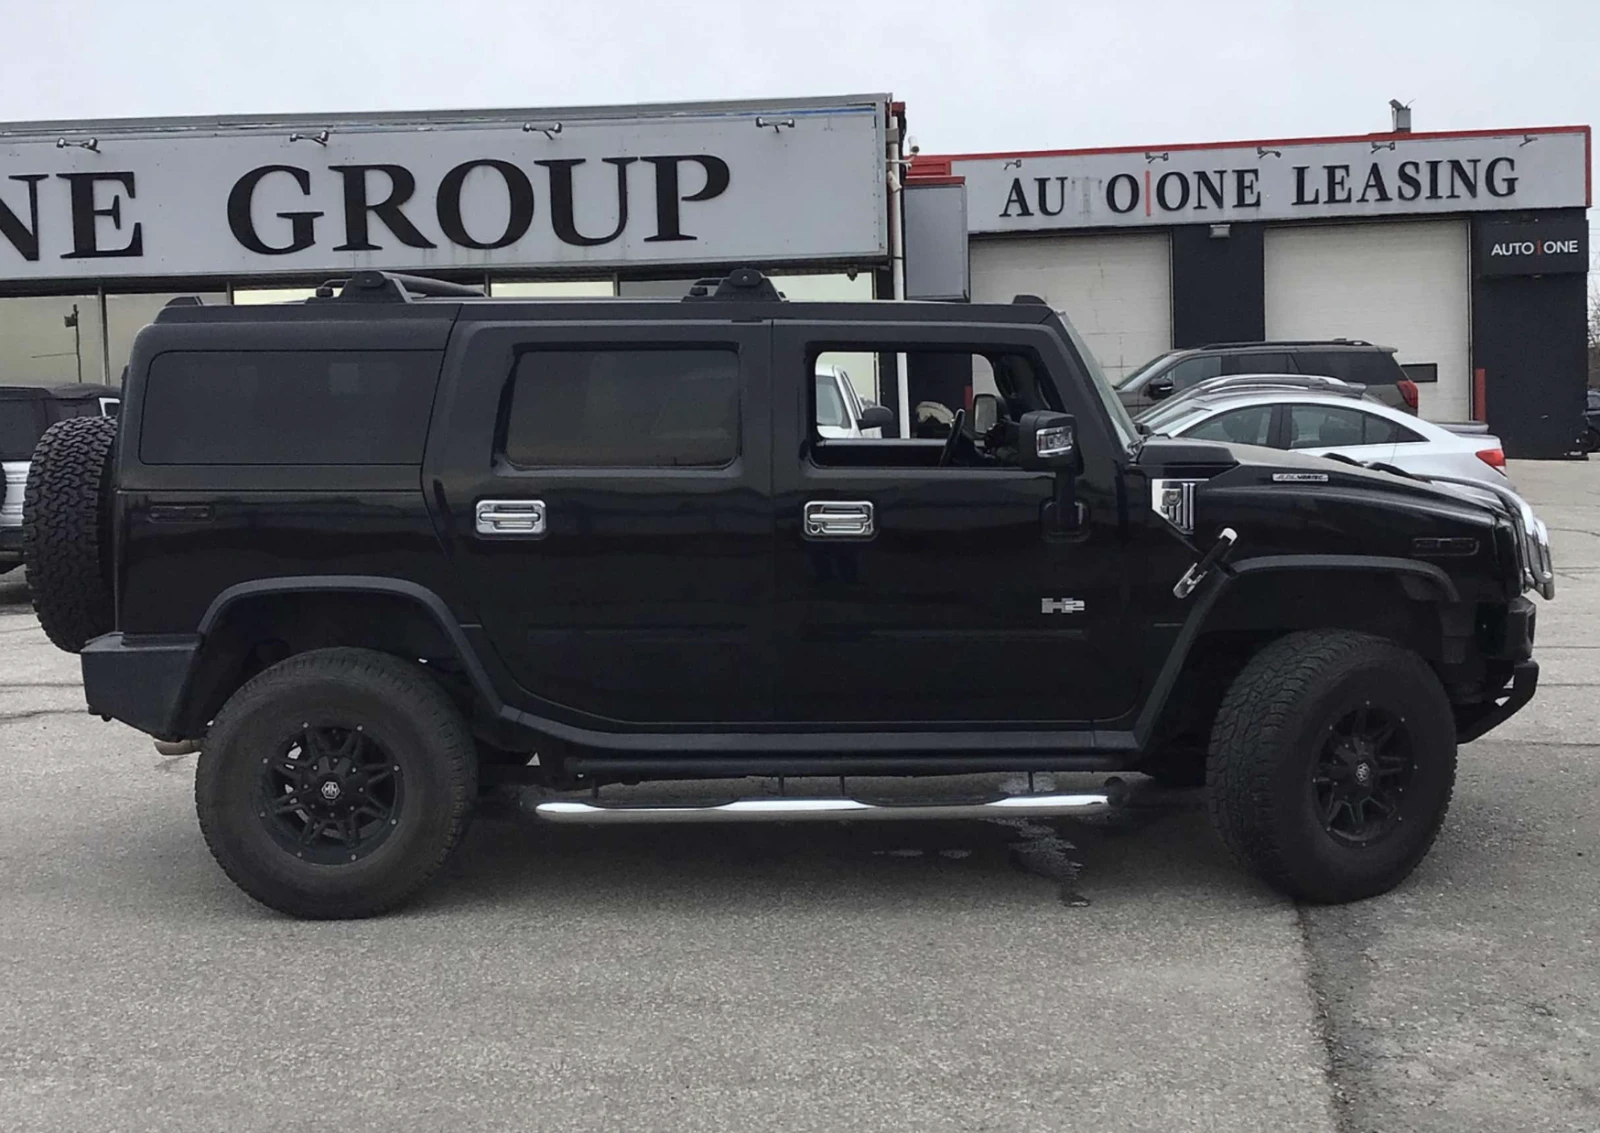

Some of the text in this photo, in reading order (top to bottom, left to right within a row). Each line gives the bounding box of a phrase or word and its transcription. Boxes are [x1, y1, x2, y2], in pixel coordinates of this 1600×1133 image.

[1291, 157, 1519, 206] LEASING
[227, 154, 730, 255] GROUP
[1491, 240, 1579, 256] AUTO ONE
[1041, 597, 1085, 614] H2
